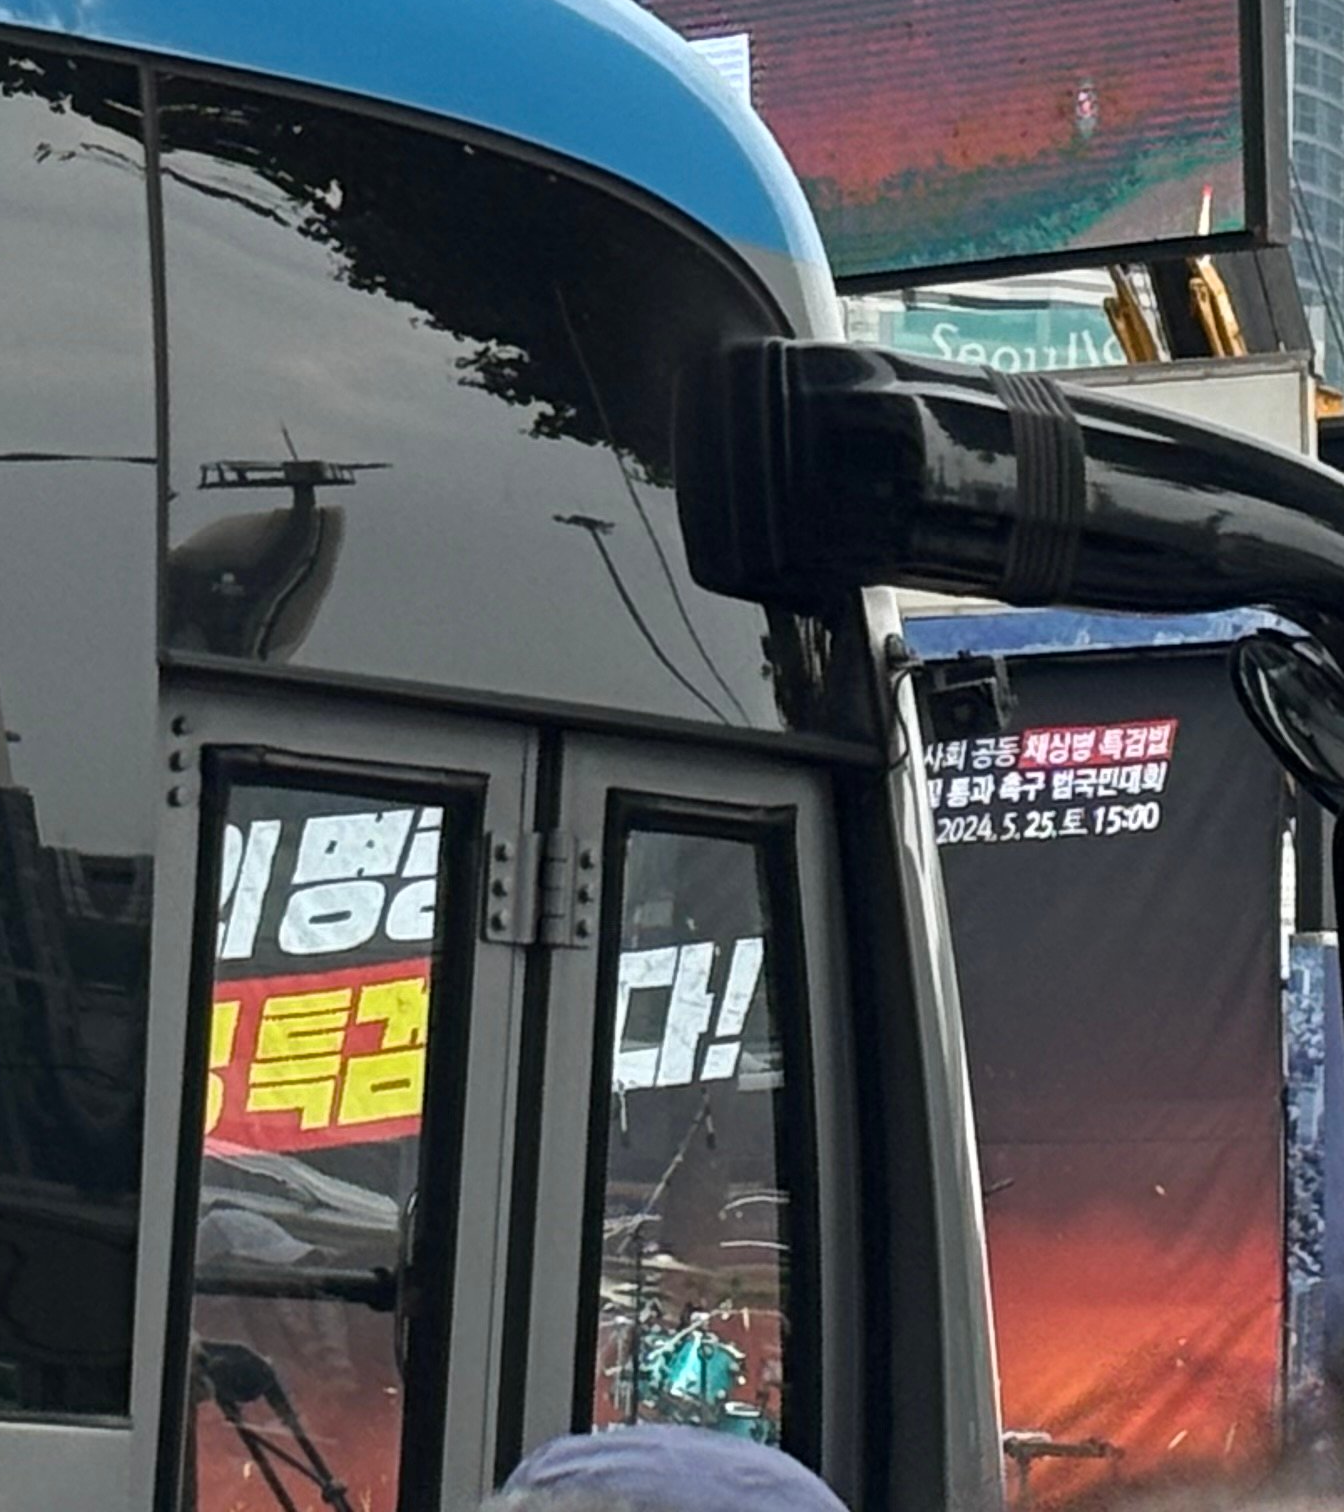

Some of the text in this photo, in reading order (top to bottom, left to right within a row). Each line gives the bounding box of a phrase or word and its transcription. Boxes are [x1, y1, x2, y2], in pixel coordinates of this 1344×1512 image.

[971, 735, 1022, 769] 공동
[947, 773, 996, 809] 통과
[1051, 760, 1169, 802] 범국민대회
